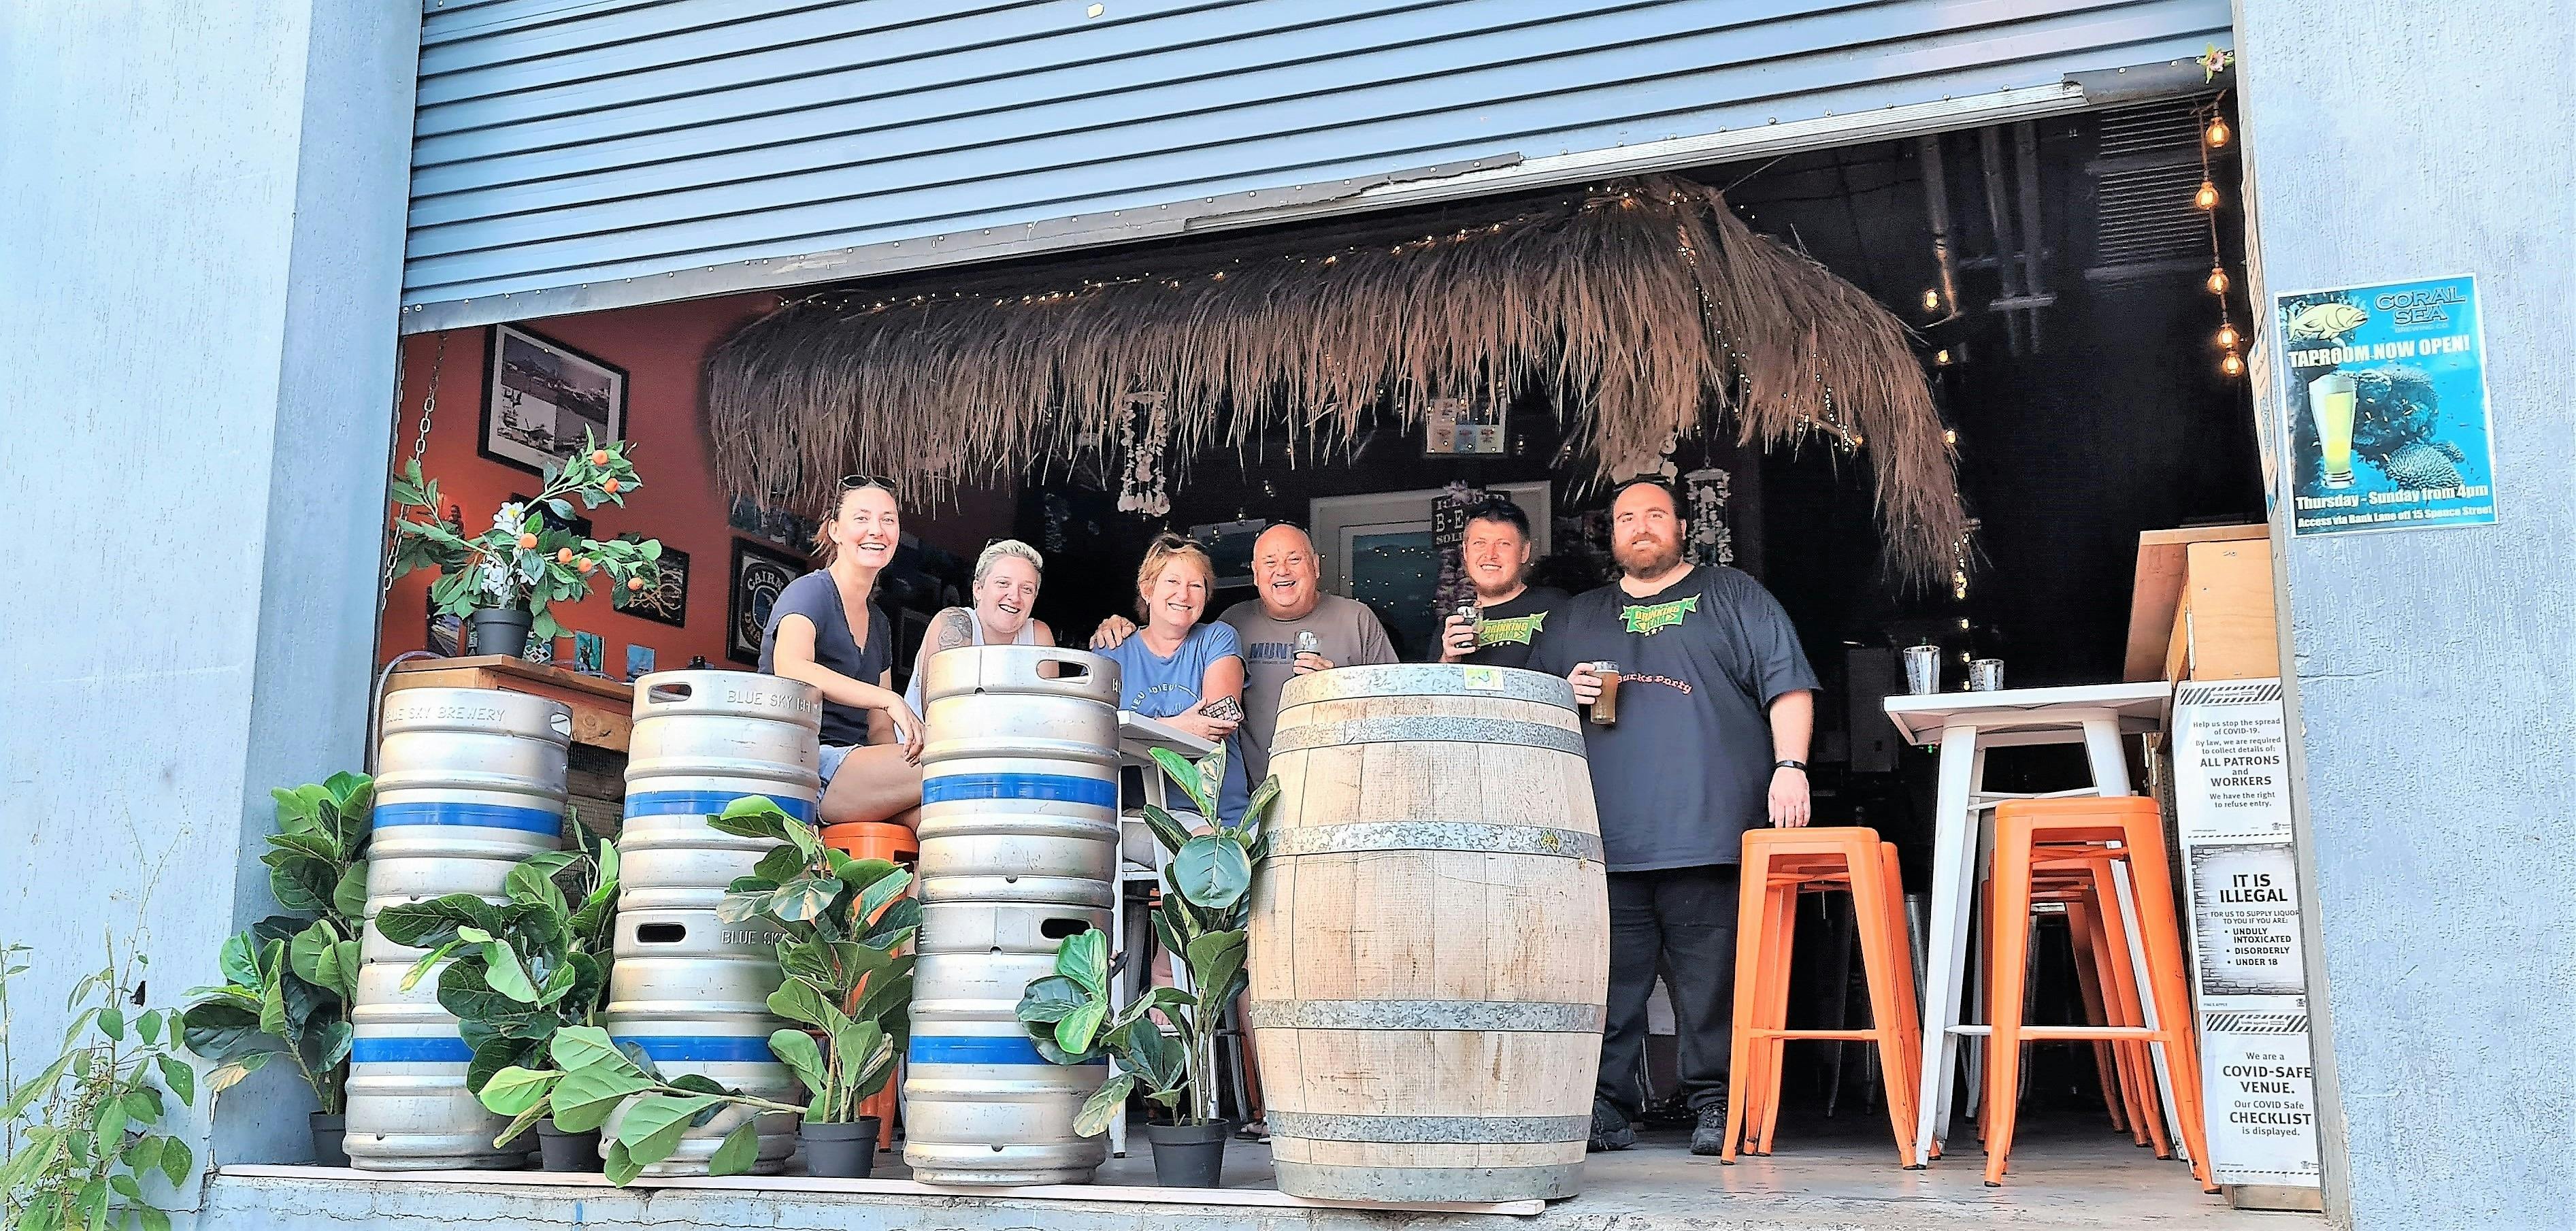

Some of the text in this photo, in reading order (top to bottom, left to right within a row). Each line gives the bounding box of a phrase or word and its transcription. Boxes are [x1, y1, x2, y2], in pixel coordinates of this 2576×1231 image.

[2375, 286, 2466, 311] CORAL
[2394, 305, 2449, 325] SEA
[2288, 334, 2471, 368] TAPROOM NOW OPEN!
[2295, 494, 2359, 510] Thursday
[2368, 489, 2420, 505] Sunday
[2421, 487, 2456, 501] from
[2457, 482, 2489, 498] 4pm
[2297, 505, 2493, 528] Access via Bank Lane off 15 Spence Street
[727, 690, 763, 705] BLUE
[770, 693, 793, 709] SKY
[2193, 721, 2210, 729] Help
[2255, 717, 2281, 727] spread
[2223, 727, 2260, 736] COVID-19.
[2249, 736, 2281, 745] required
[2265, 744, 2276, 753] of:
[2200, 755, 2280, 768] ALL PATRONS
[2232, 768, 2249, 776] and
[2210, 776, 2272, 787] WORKERS
[2257, 791, 2275, 802] right
[2224, 800, 2247, 808] refuse
[2249, 800, 2272, 808] entry.
[2232, 874, 2270, 887] IT IS
[2219, 888, 2288, 903] ILLEGAL
[721, 929, 757, 945] BLUE
[2232, 928, 2268, 936] UNDULY
[2233, 935, 2292, 944] INTOXICATED
[2234, 947, 2290, 955] DISORDERLY
[2246, 1052, 2260, 1060] We
[2223, 1066, 2312, 1078] COVID-SAFE
[2240, 1081, 2295, 1094] VENUE.
[2234, 1100, 2305, 1109] Our COVID Safe
[2230, 1112, 2311, 1125] CHECKLIST
[2252, 1127, 2300, 1137] displayed.
